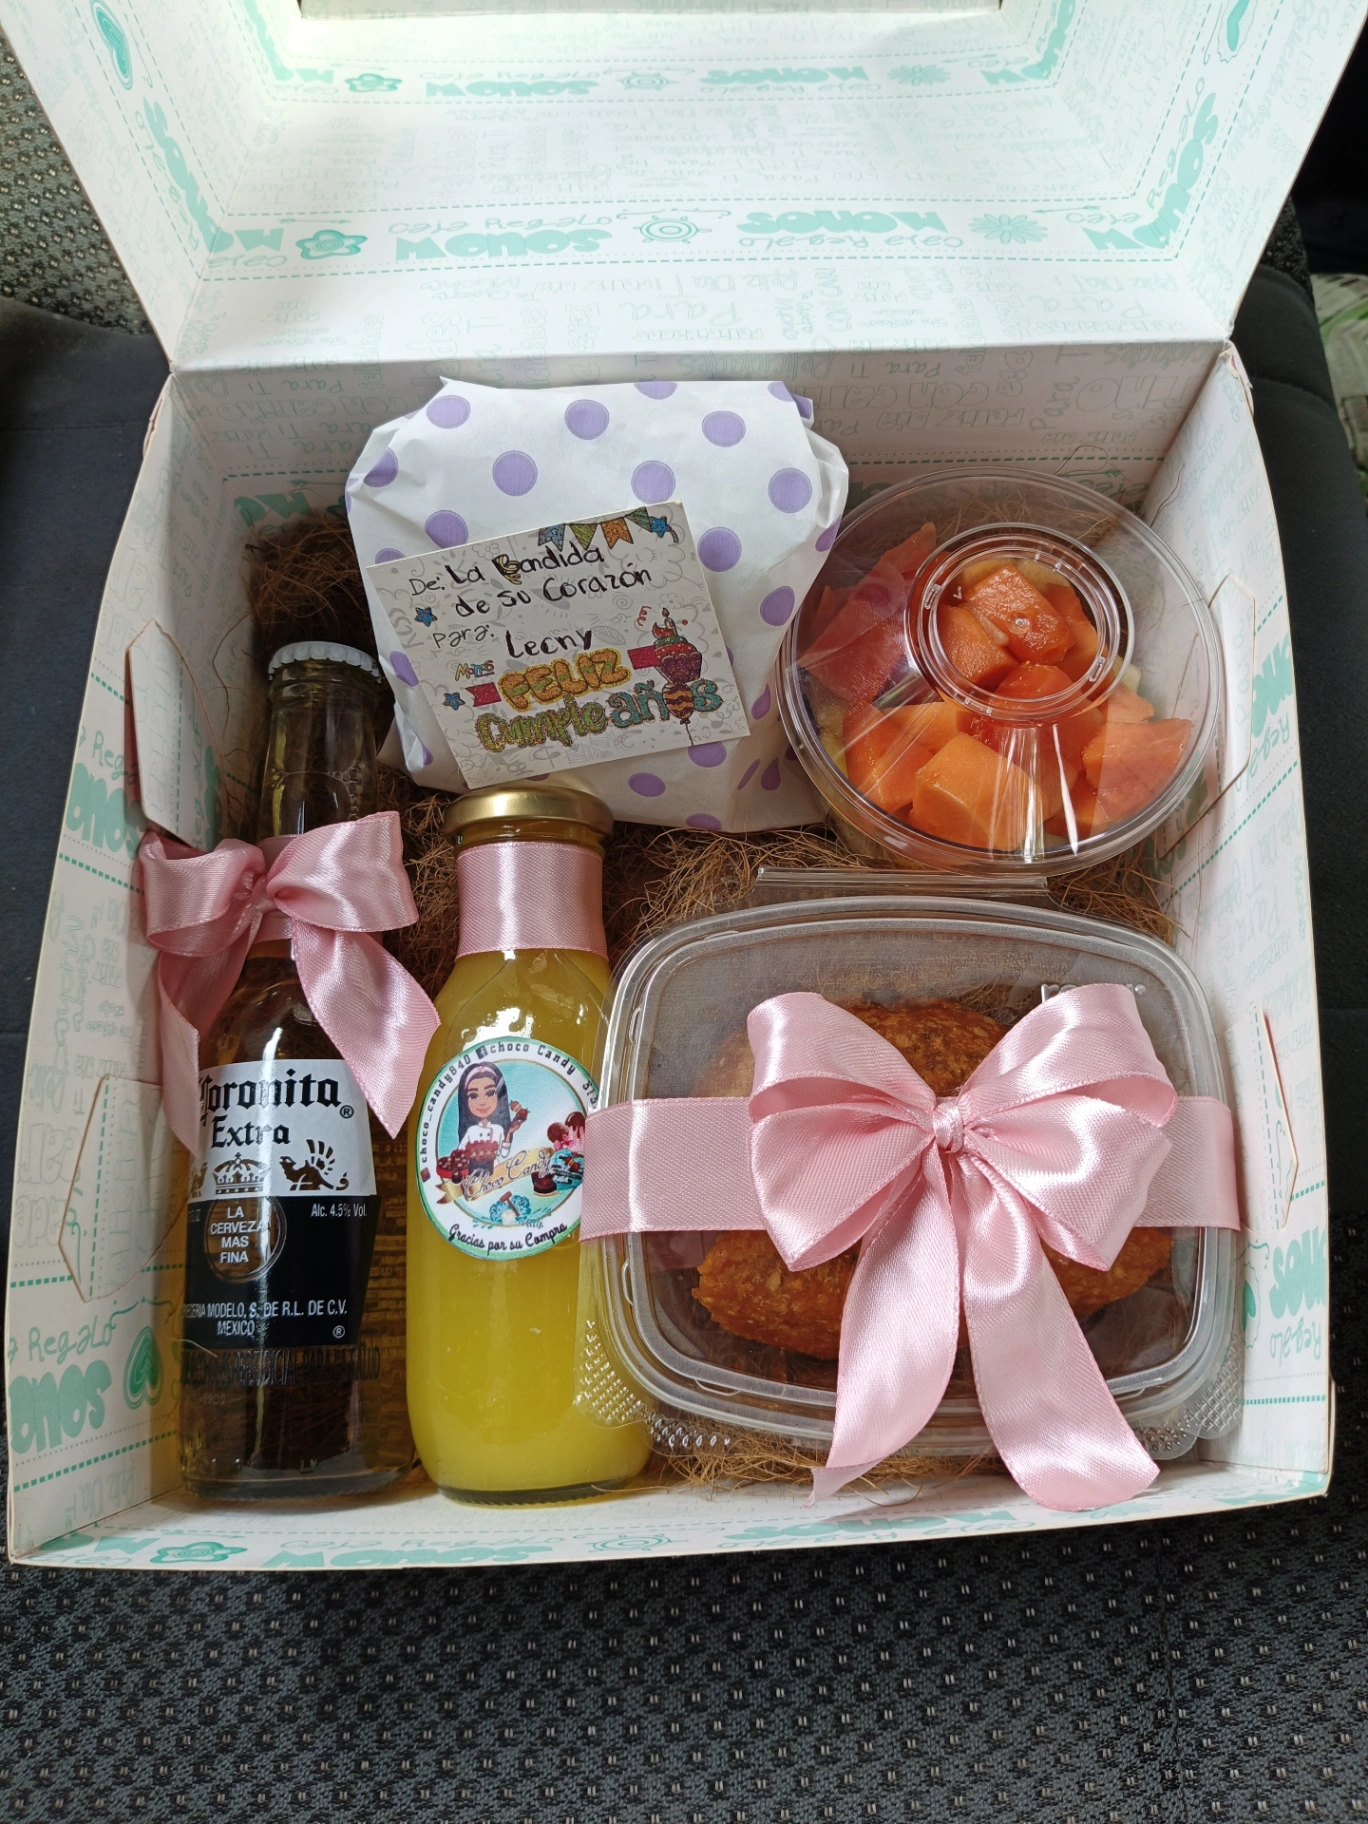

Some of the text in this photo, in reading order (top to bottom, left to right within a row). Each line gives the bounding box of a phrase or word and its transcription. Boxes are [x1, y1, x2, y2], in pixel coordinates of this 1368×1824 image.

[388, 219, 470, 235] Caja
[445, 564, 486, 585] La
[492, 541, 605, 576] Bandida
[455, 595, 491, 618] de
[499, 648, 632, 712] FELIZ
[211, 1113, 291, 1149] Extra
[226, 1206, 244, 1219] LA
[311, 1202, 368, 1217] Alc. 4.5% Vol.
[210, 1220, 268, 1235] CERVEZA
[221, 1235, 249, 1248] MAS
[448, 1223, 486, 1249] Gracias
[487, 1240, 507, 1256] por
[510, 1240, 524, 1251] su
[525, 1221, 568, 1247] Compra
[219, 1251, 249, 1264] FINA
[263, 1301, 279, 1318] DE
[282, 1300, 304, 1317] R.L.
[308, 1299, 324, 1317] DE
[327, 1299, 348, 1316] C.V.
[217, 1319, 255, 1337] MEXICO
[10, 1358, 113, 1456] ONOS
